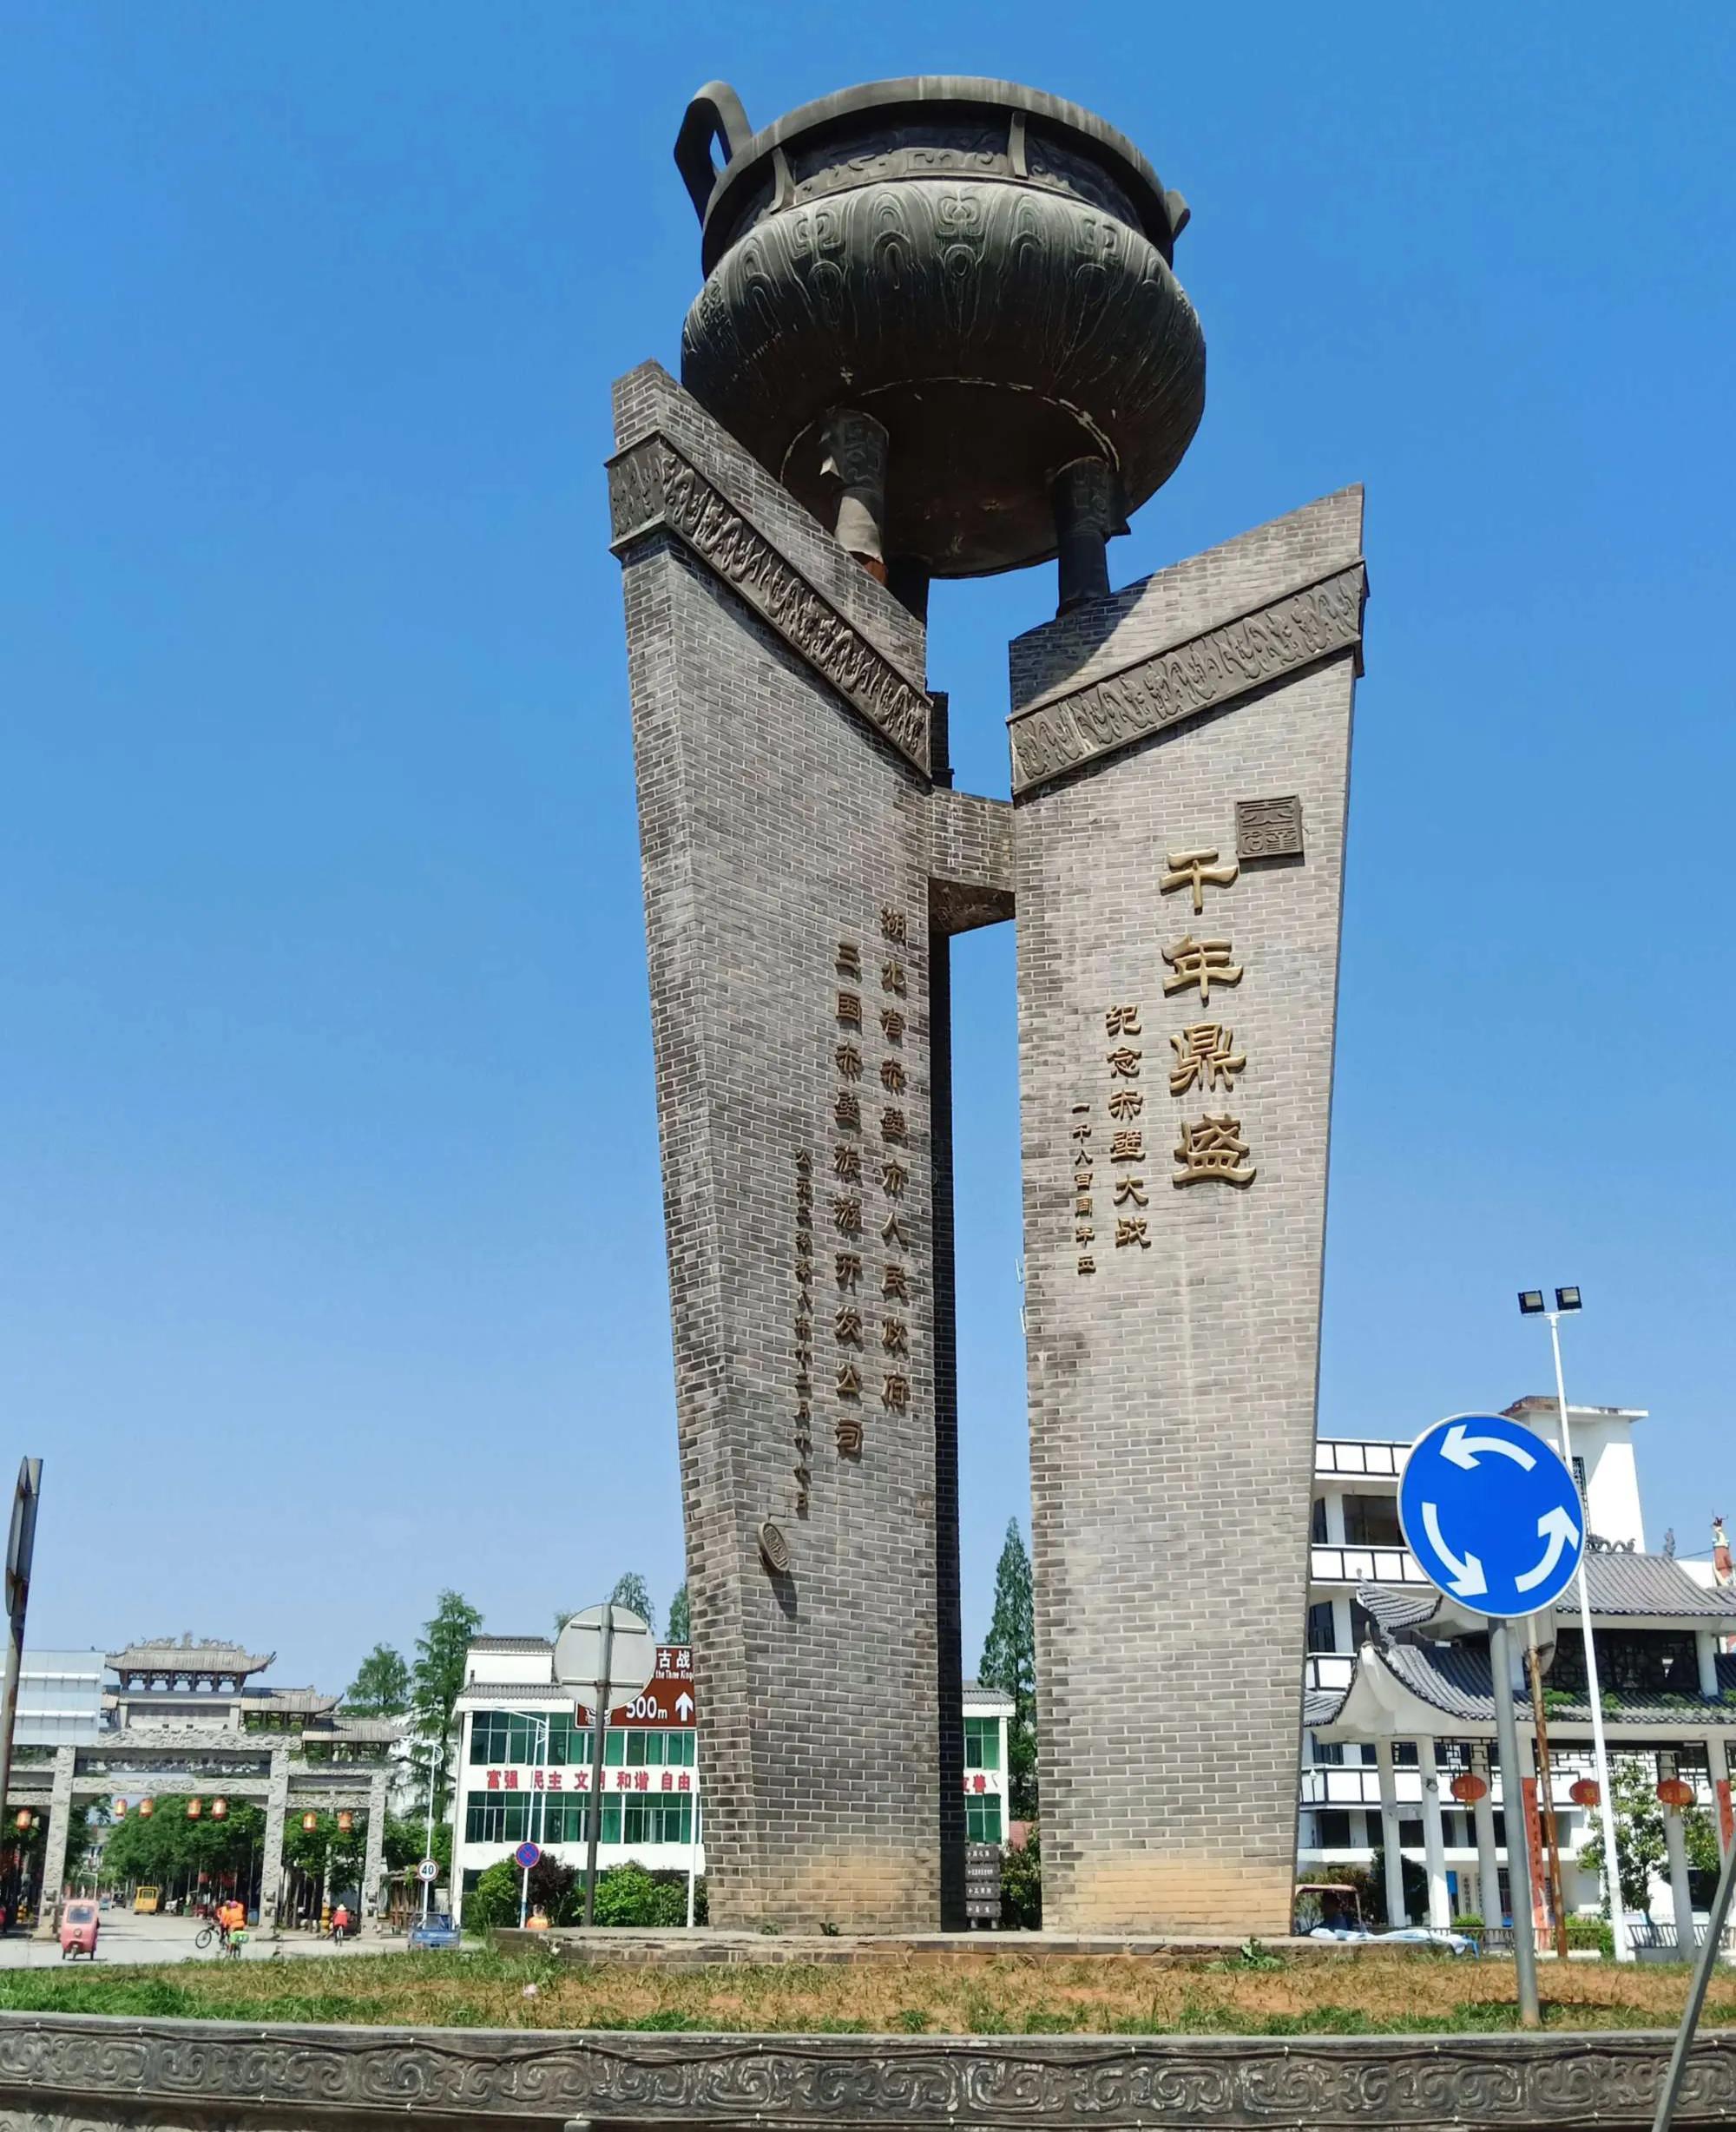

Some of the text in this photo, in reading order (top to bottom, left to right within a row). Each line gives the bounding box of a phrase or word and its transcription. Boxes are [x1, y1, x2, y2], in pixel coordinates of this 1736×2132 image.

[880, 906, 911, 1410] 湖北省赤壁市人民政府
[1106, 1004, 1151, 1248] 纪念赤壁大战
[1160, 846, 1256, 1188] 千年鼎盛
[835, 941, 863, 1455] 三国赤壁旅游开发公司
[422, 1865, 434, 1875] 40
[487, 1769, 518, 1790] 富强
[531, 1770, 562, 1790] 民主
[617, 1771, 649, 1790] 和谐
[661, 1771, 691, 1791] 自由
